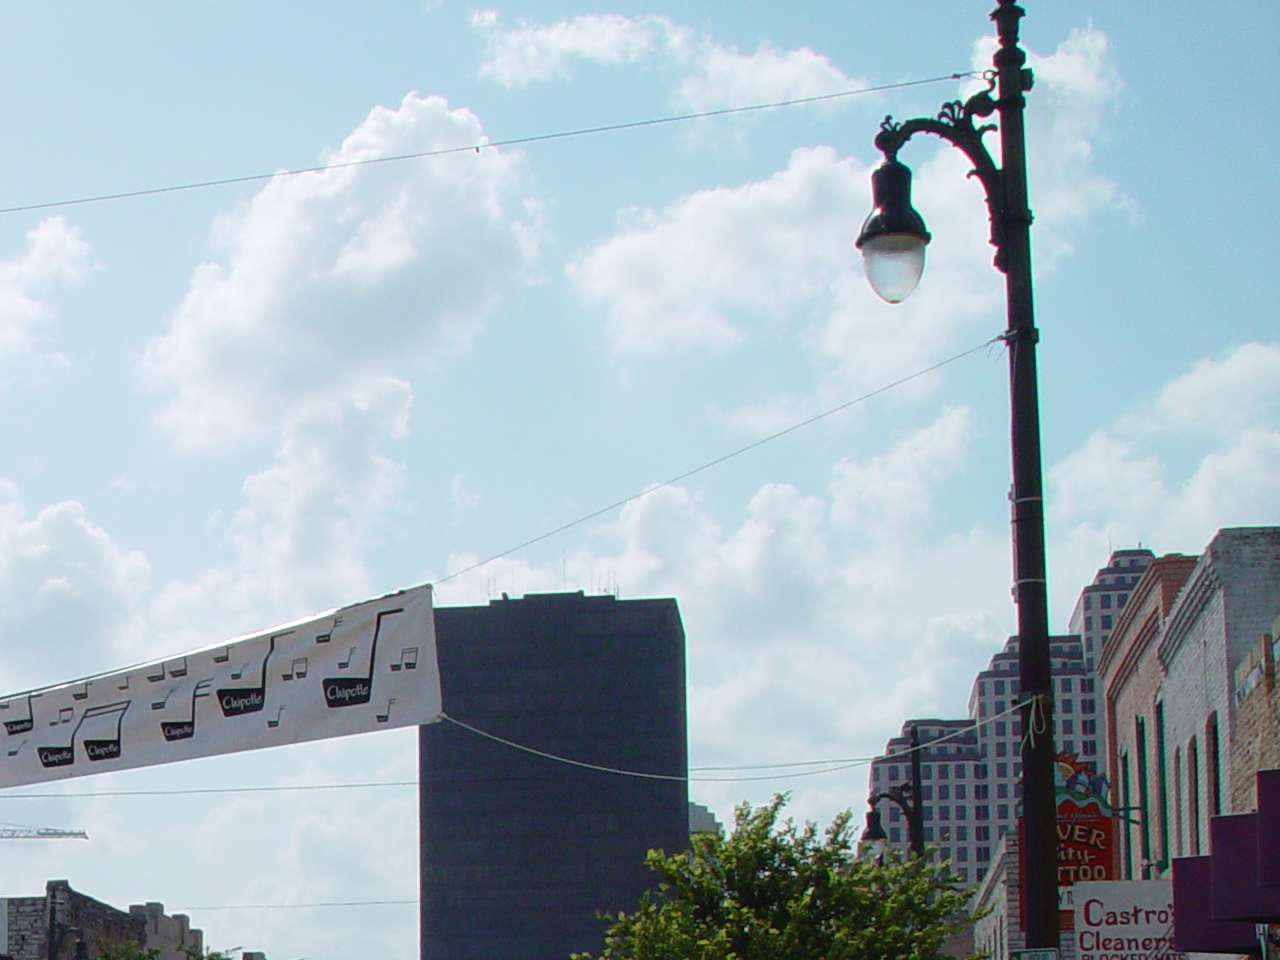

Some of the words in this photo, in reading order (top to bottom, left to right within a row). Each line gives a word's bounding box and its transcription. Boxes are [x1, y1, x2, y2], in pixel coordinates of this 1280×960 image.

[327, 684, 370, 700] Chipotle
[222, 693, 263, 710] Chipotle
[164, 724, 193, 736] Chipotle
[41, 752, 71, 764] Chipotle
[88, 744, 119, 757] Chipotle
[1056, 824, 1107, 849] VER
[1057, 865, 1107, 882] TTOO
